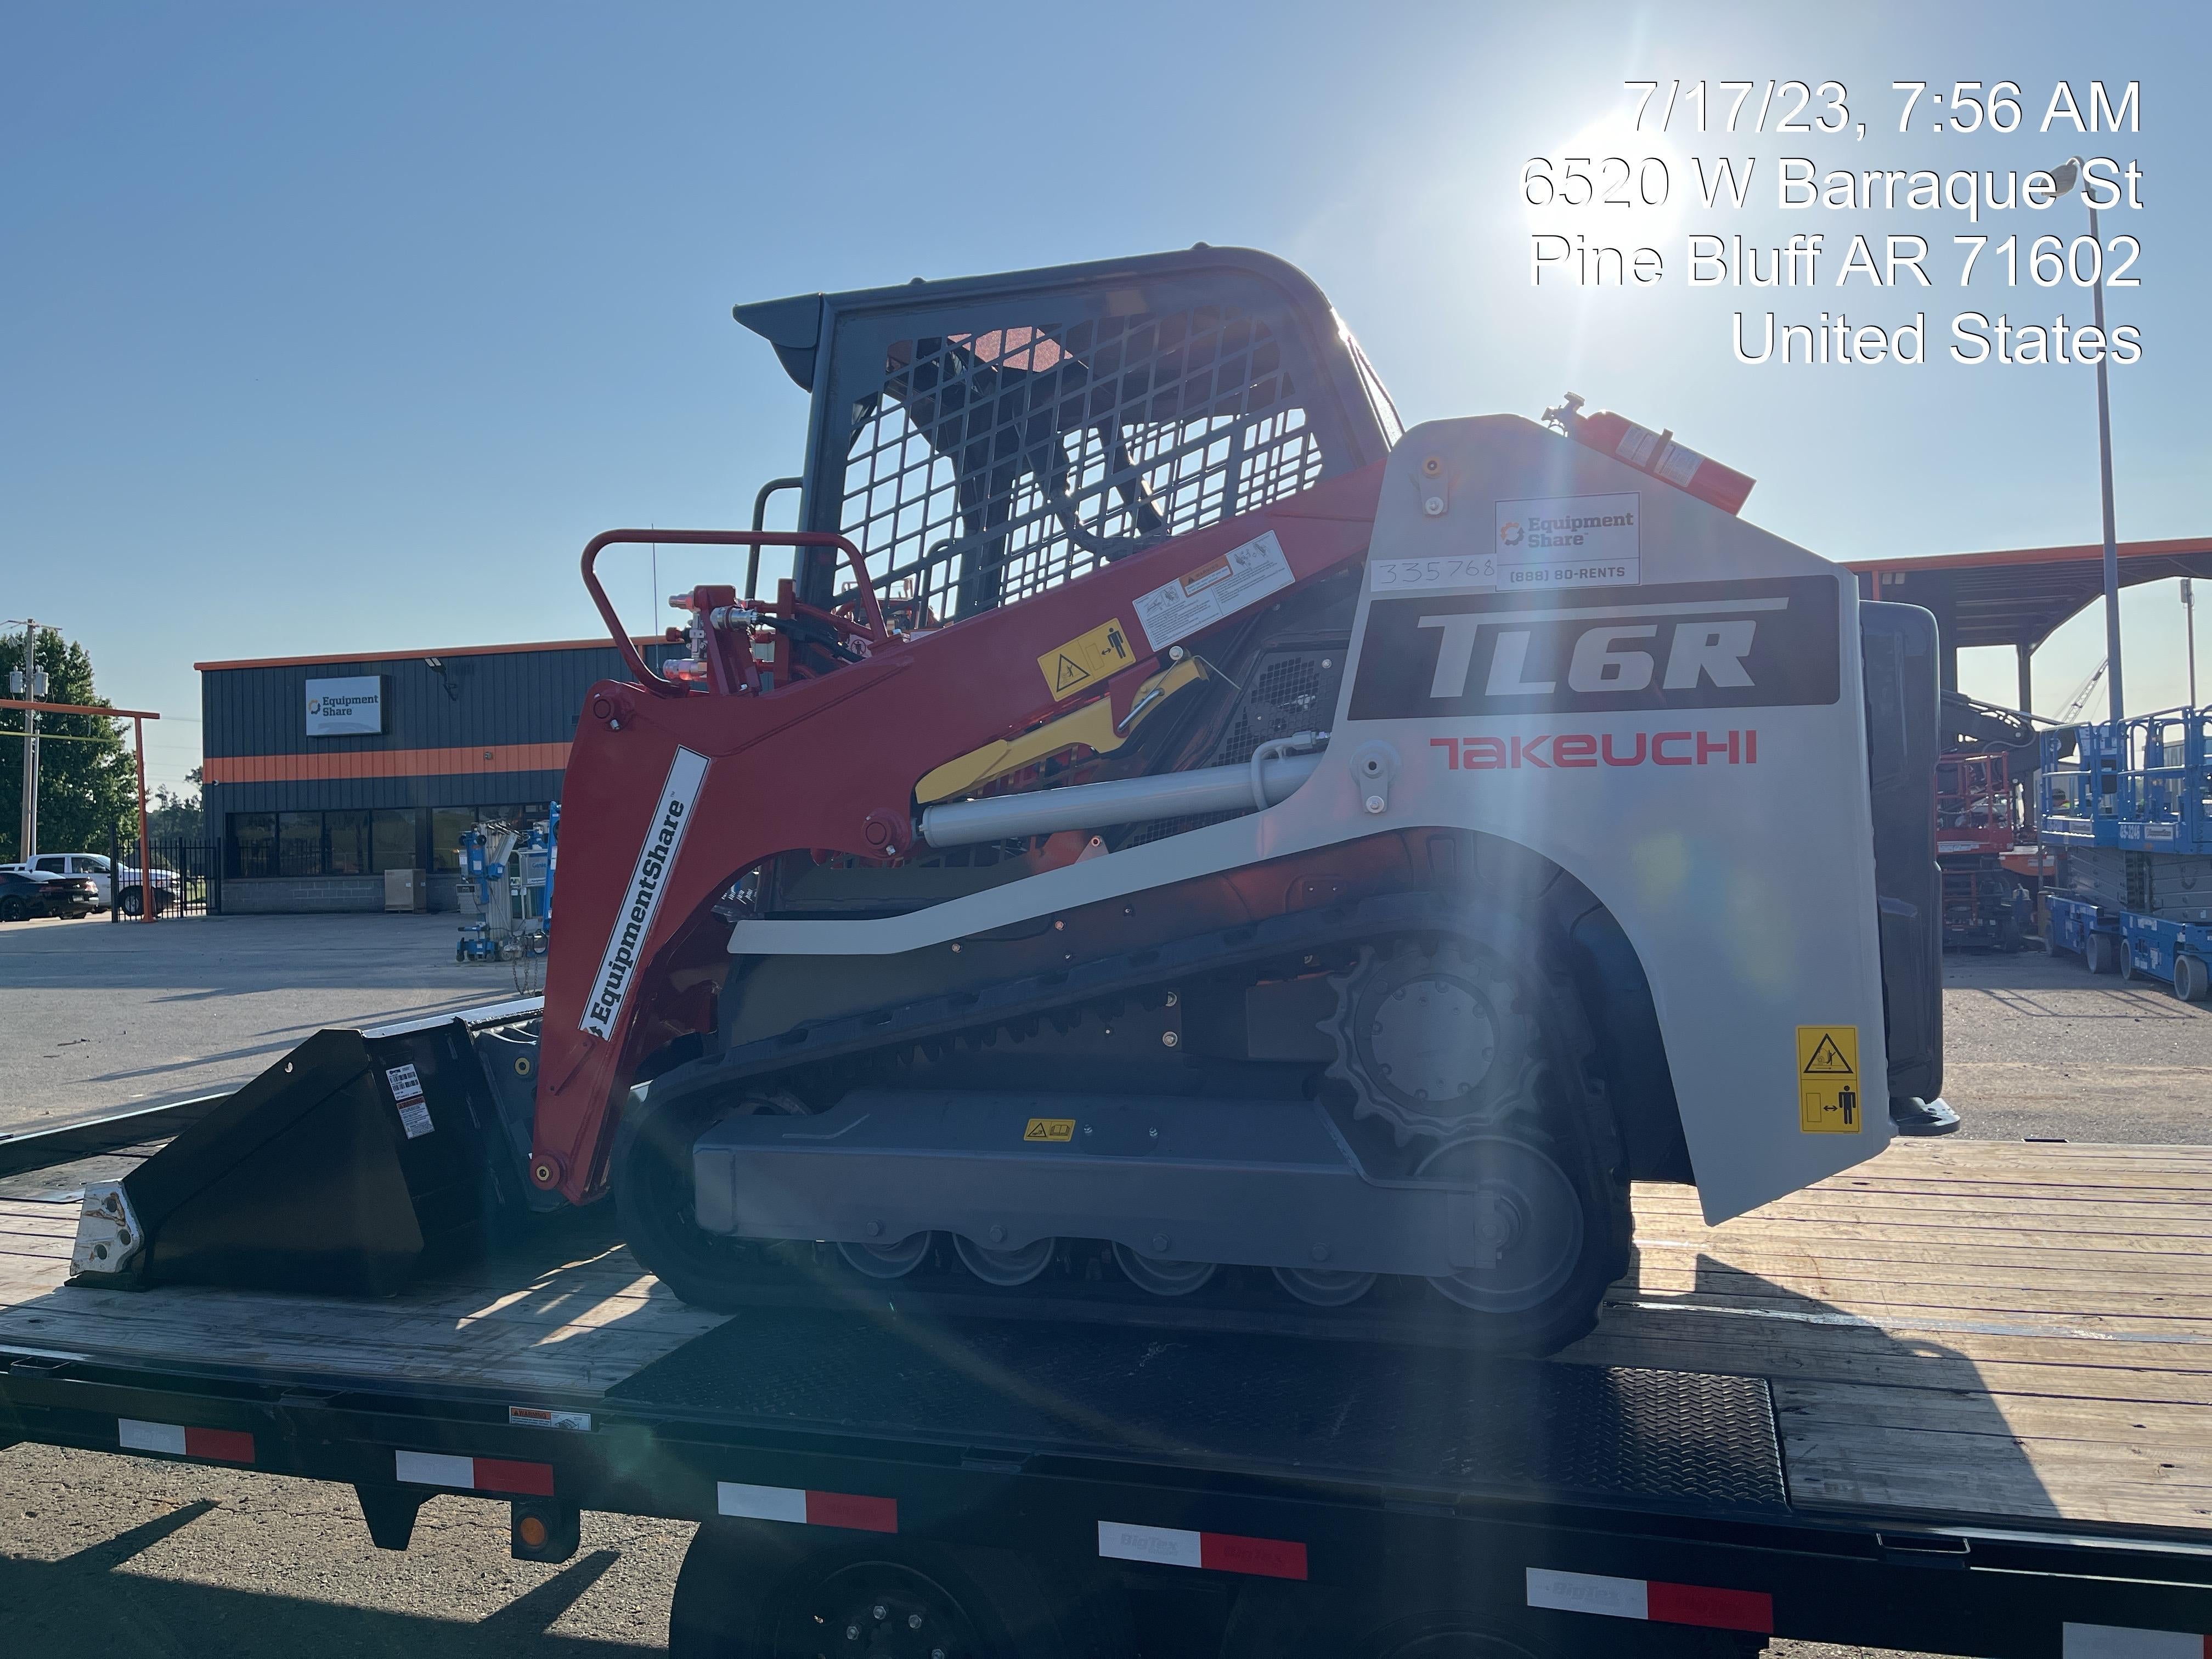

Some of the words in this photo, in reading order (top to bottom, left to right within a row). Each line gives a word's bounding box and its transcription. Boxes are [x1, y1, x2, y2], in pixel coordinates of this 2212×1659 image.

[1527, 512, 1634, 533] Equipment
[1527, 533, 1584, 548] Share
[1379, 558, 1495, 584] 335768
[1510, 569, 1549, 583] (888)
[1554, 567, 1626, 580] 80-RENTS
[1417, 597, 1789, 698] TL6R
[322, 695, 379, 707] Equipment
[323, 707, 352, 716] Share
[590, 799, 684, 1025] EquipmentShare
[518, 1409, 547, 1419] WARNING
